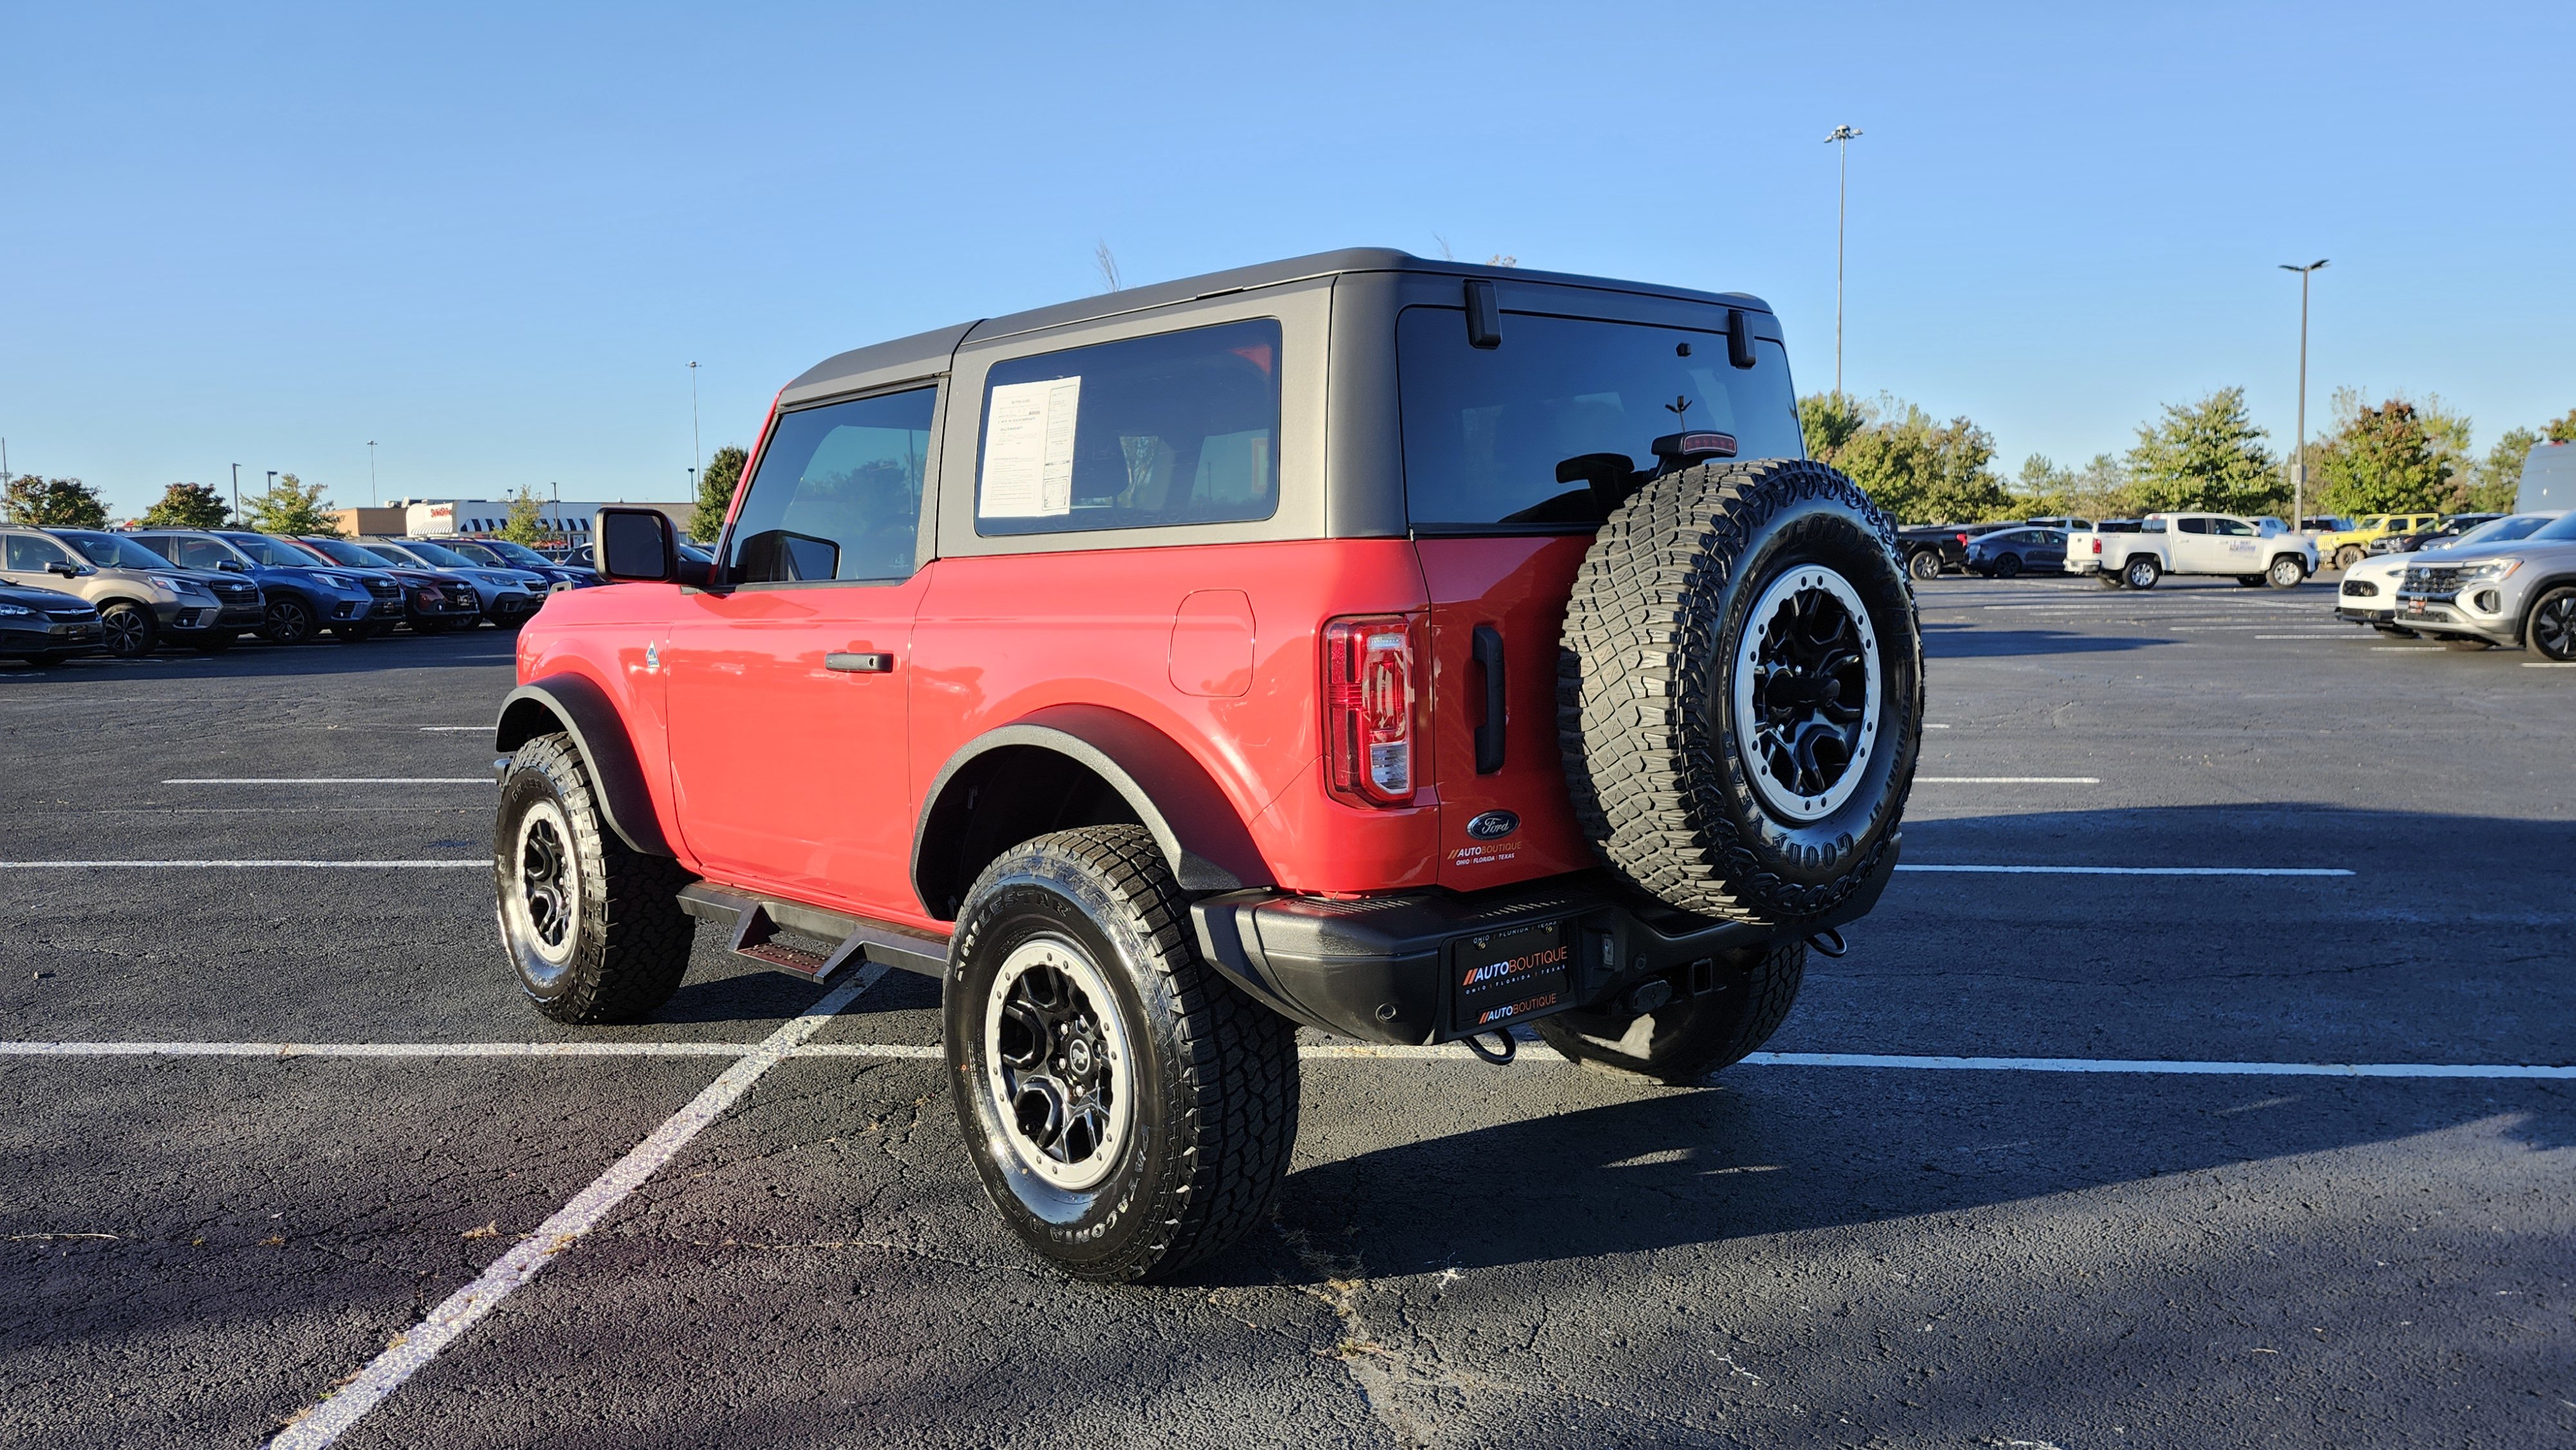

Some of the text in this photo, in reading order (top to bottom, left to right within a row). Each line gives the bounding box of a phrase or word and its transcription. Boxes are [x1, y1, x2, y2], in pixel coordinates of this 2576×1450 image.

[1481, 818, 1510, 834] Ford
[1473, 934, 1490, 944] OHIO
[1465, 964, 1566, 995] OHIO FLORIDA TEXAS
